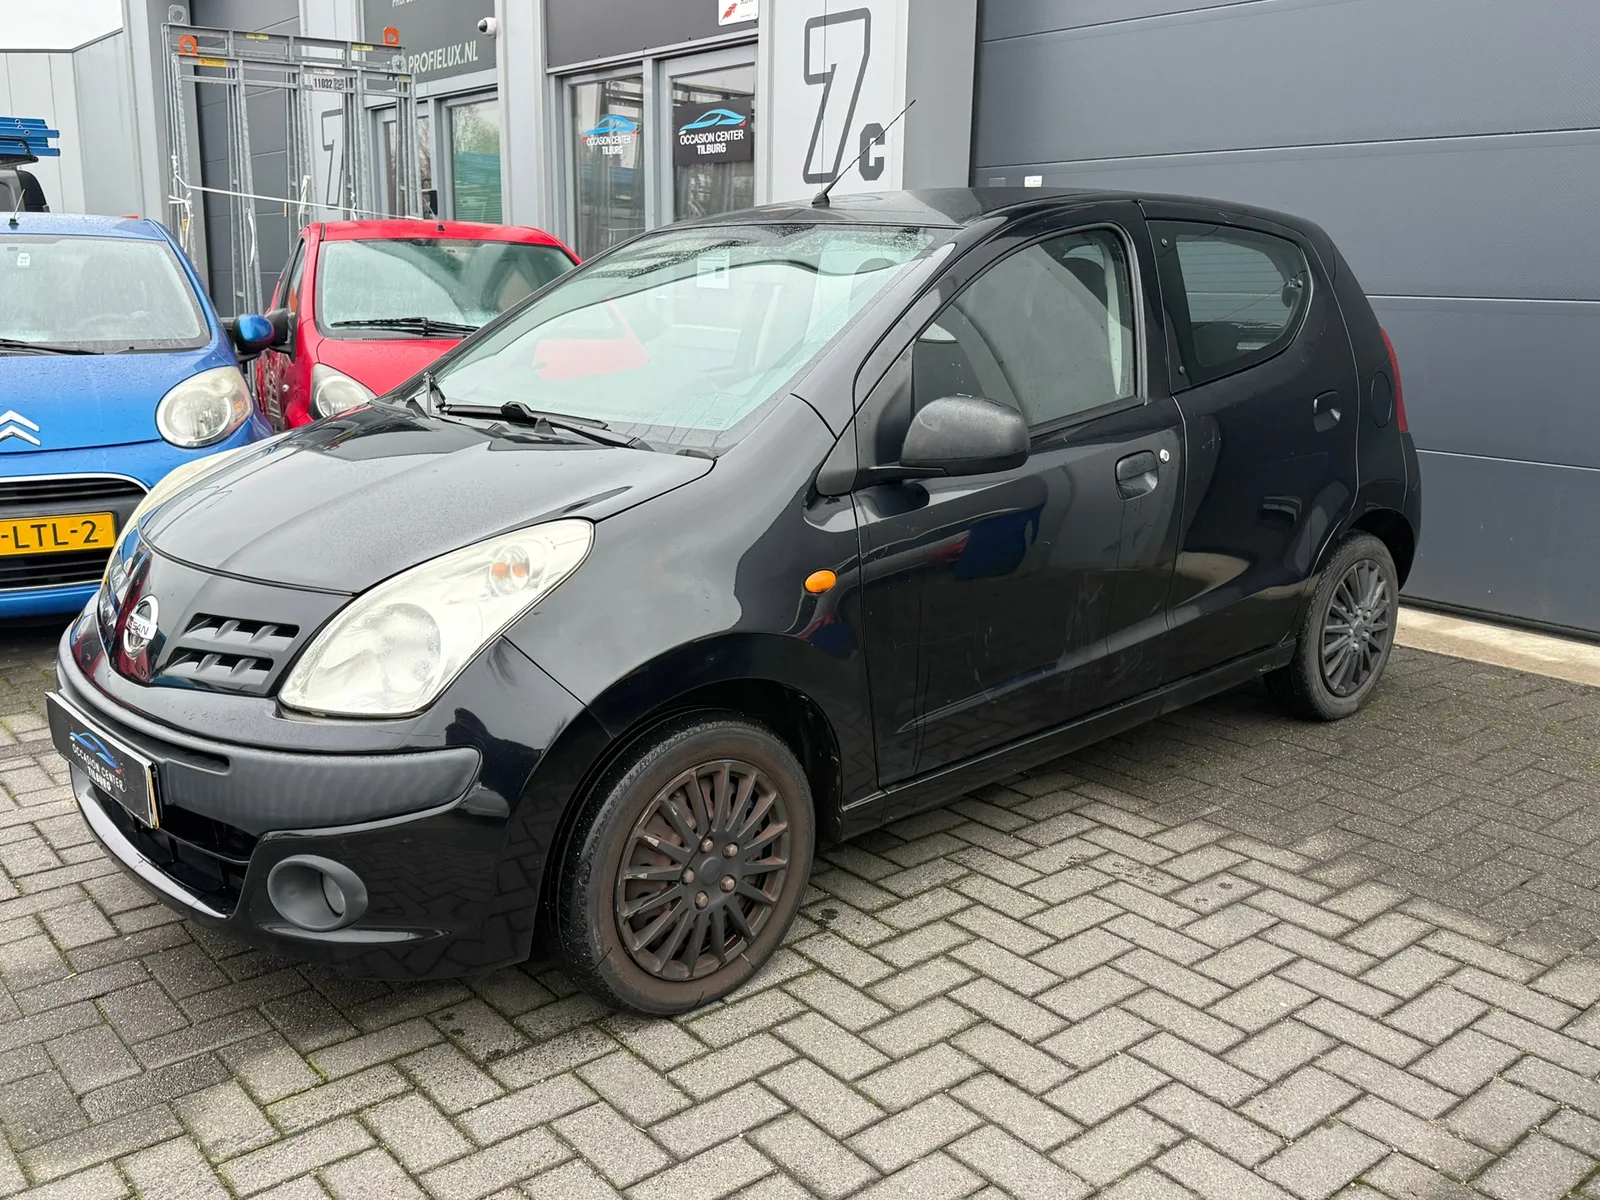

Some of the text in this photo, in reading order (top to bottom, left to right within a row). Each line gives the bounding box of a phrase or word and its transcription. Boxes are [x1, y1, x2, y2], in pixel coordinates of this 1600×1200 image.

[408, 40, 479, 75] PROFIELUX.NL
[679, 129, 744, 146] OCCASION CENTER
[601, 145, 623, 155] TILBURG
[696, 142, 727, 155] TILBURG
[71, 743, 124, 791] OCCASION CENTER
